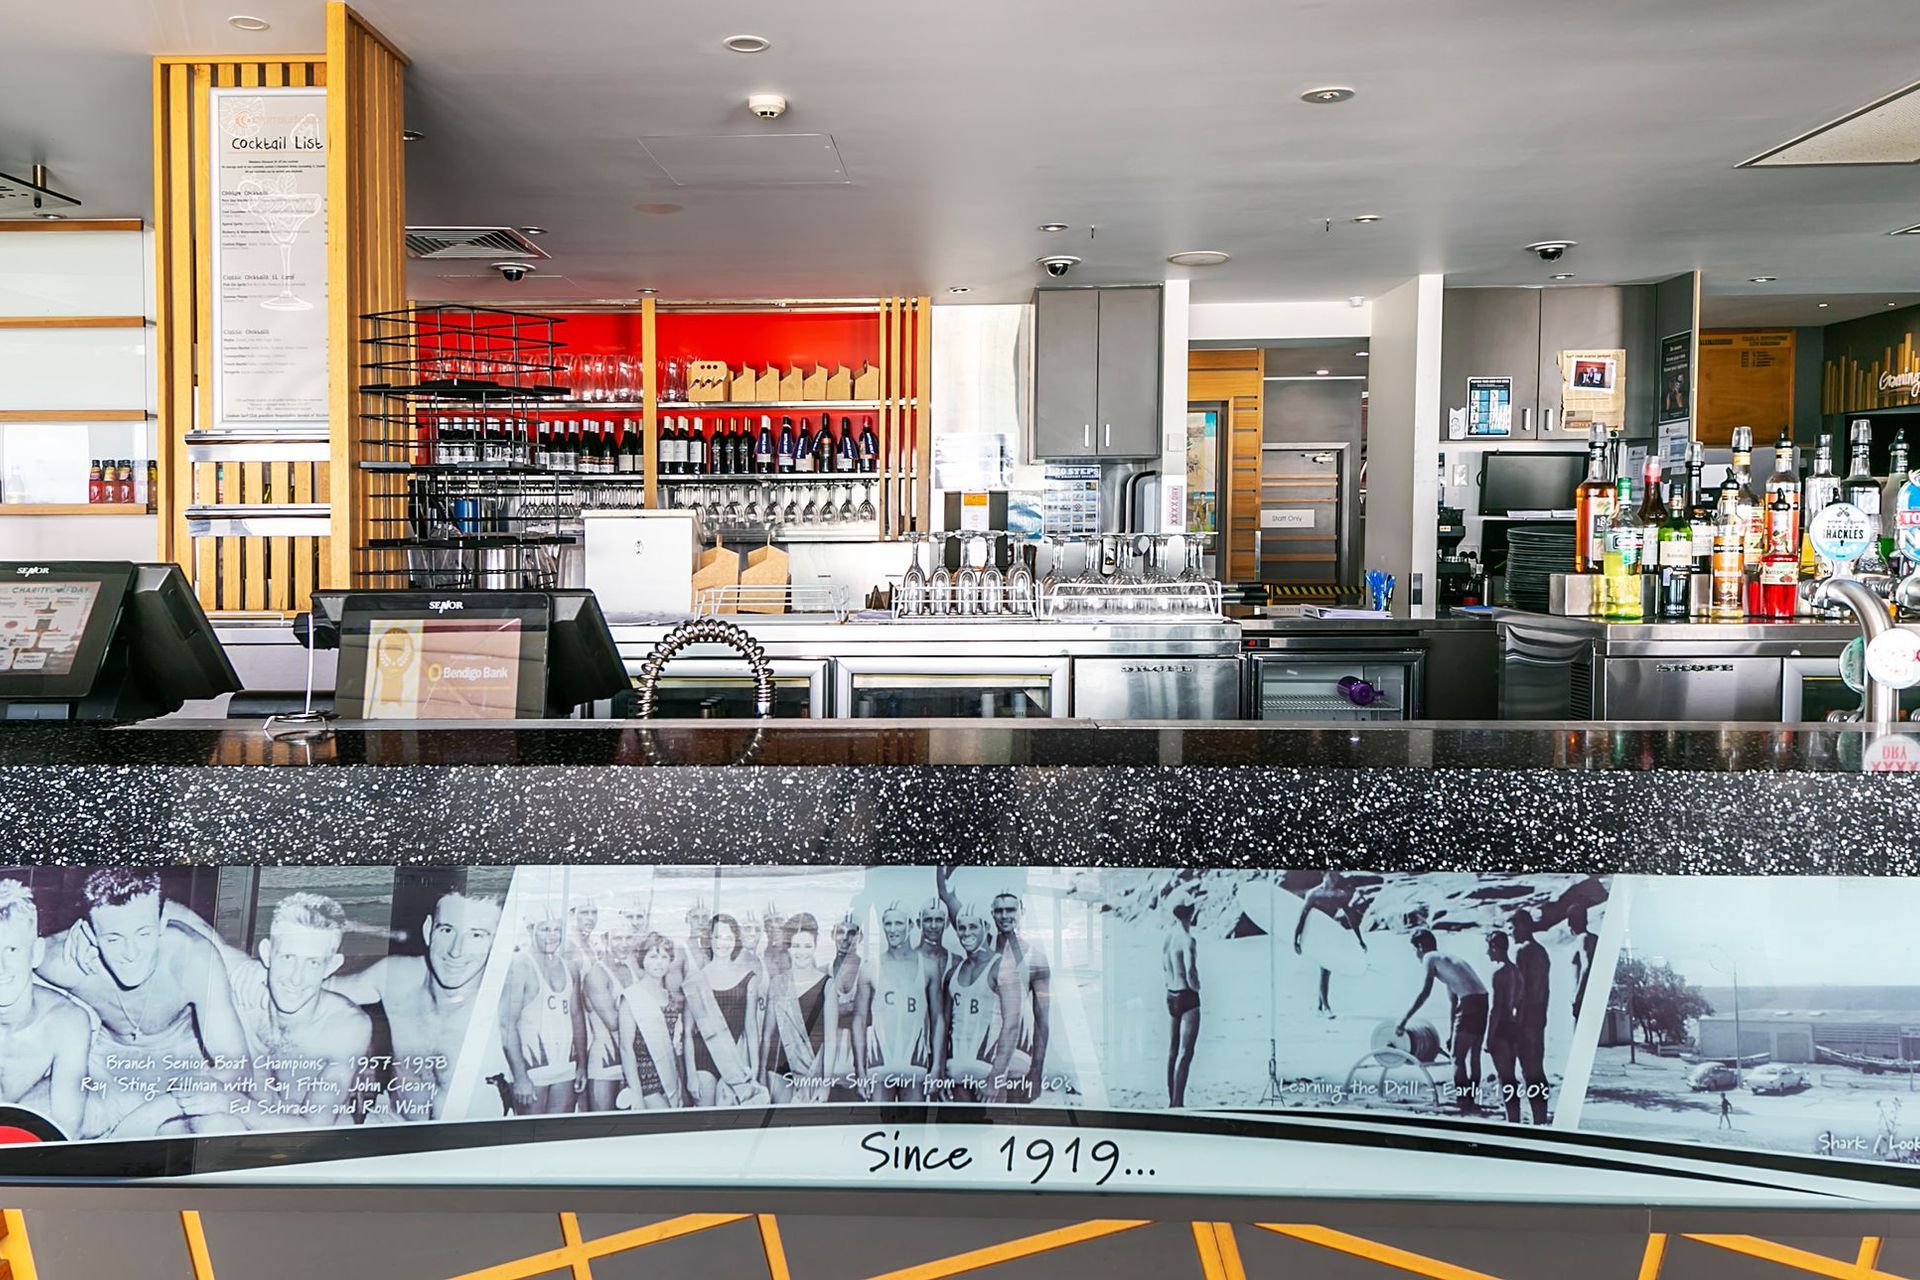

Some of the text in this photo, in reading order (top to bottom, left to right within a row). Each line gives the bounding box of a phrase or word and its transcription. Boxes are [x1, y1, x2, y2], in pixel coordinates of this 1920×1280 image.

[231, 136, 324, 151] Cocktail List
[1067, 467, 1099, 476] STEPS
[1271, 513, 1303, 523] Staff Only
[443, 666, 508, 681] Bendigo Bank
[106, 1055, 155, 1071] Branch
[163, 1055, 208, 1071] Senior
[214, 1055, 248, 1070] Boat
[253, 1055, 325, 1074] Champions
[348, 1055, 448, 1073] 1957-1958
[80, 1077, 107, 1098] Ray
[166, 1077, 217, 1092] Zillman
[223, 1077, 257, 1092] with
[263, 1077, 291, 1098] Ray
[296, 1077, 341, 1096] Fitton,
[348, 1077, 381, 1094] John
[387, 1077, 439, 1099] Cleary,
[782, 1072, 1074, 1098] Summer Surf Girl from the Early 60's
[1279, 1078, 1347, 1104] Learning
[1350, 1079, 1378, 1095] the
[1384, 1079, 1419, 1096] Drill
[1442, 1079, 1482, 1101] Early
[1488, 1080, 1550, 1103] 1960's
[229, 1100, 433, 1115] Ed Schrader and Ron Want
[1818, 1133, 1868, 1151] Shark
[860, 1129, 1157, 1186] Since 1919...
